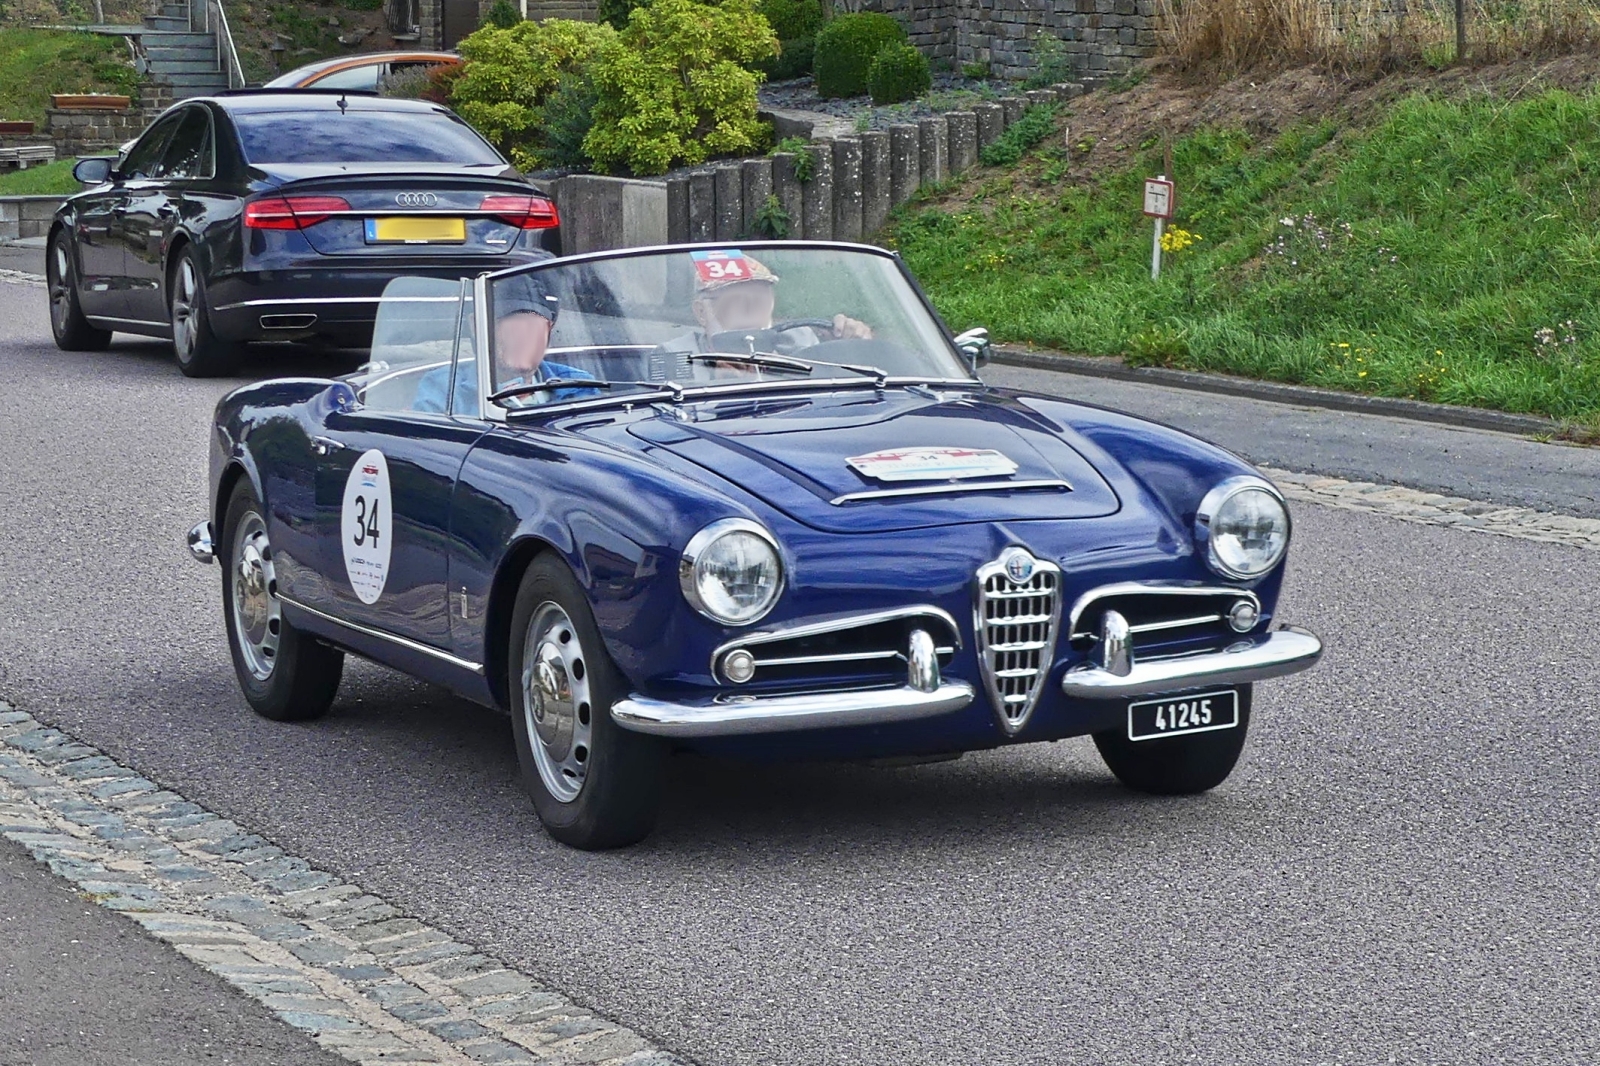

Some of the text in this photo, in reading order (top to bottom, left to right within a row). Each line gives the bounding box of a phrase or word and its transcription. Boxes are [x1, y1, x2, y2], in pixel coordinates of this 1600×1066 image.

[705, 260, 743, 278] 34
[353, 495, 380, 549] 34
[1155, 700, 1212, 730] 41245
